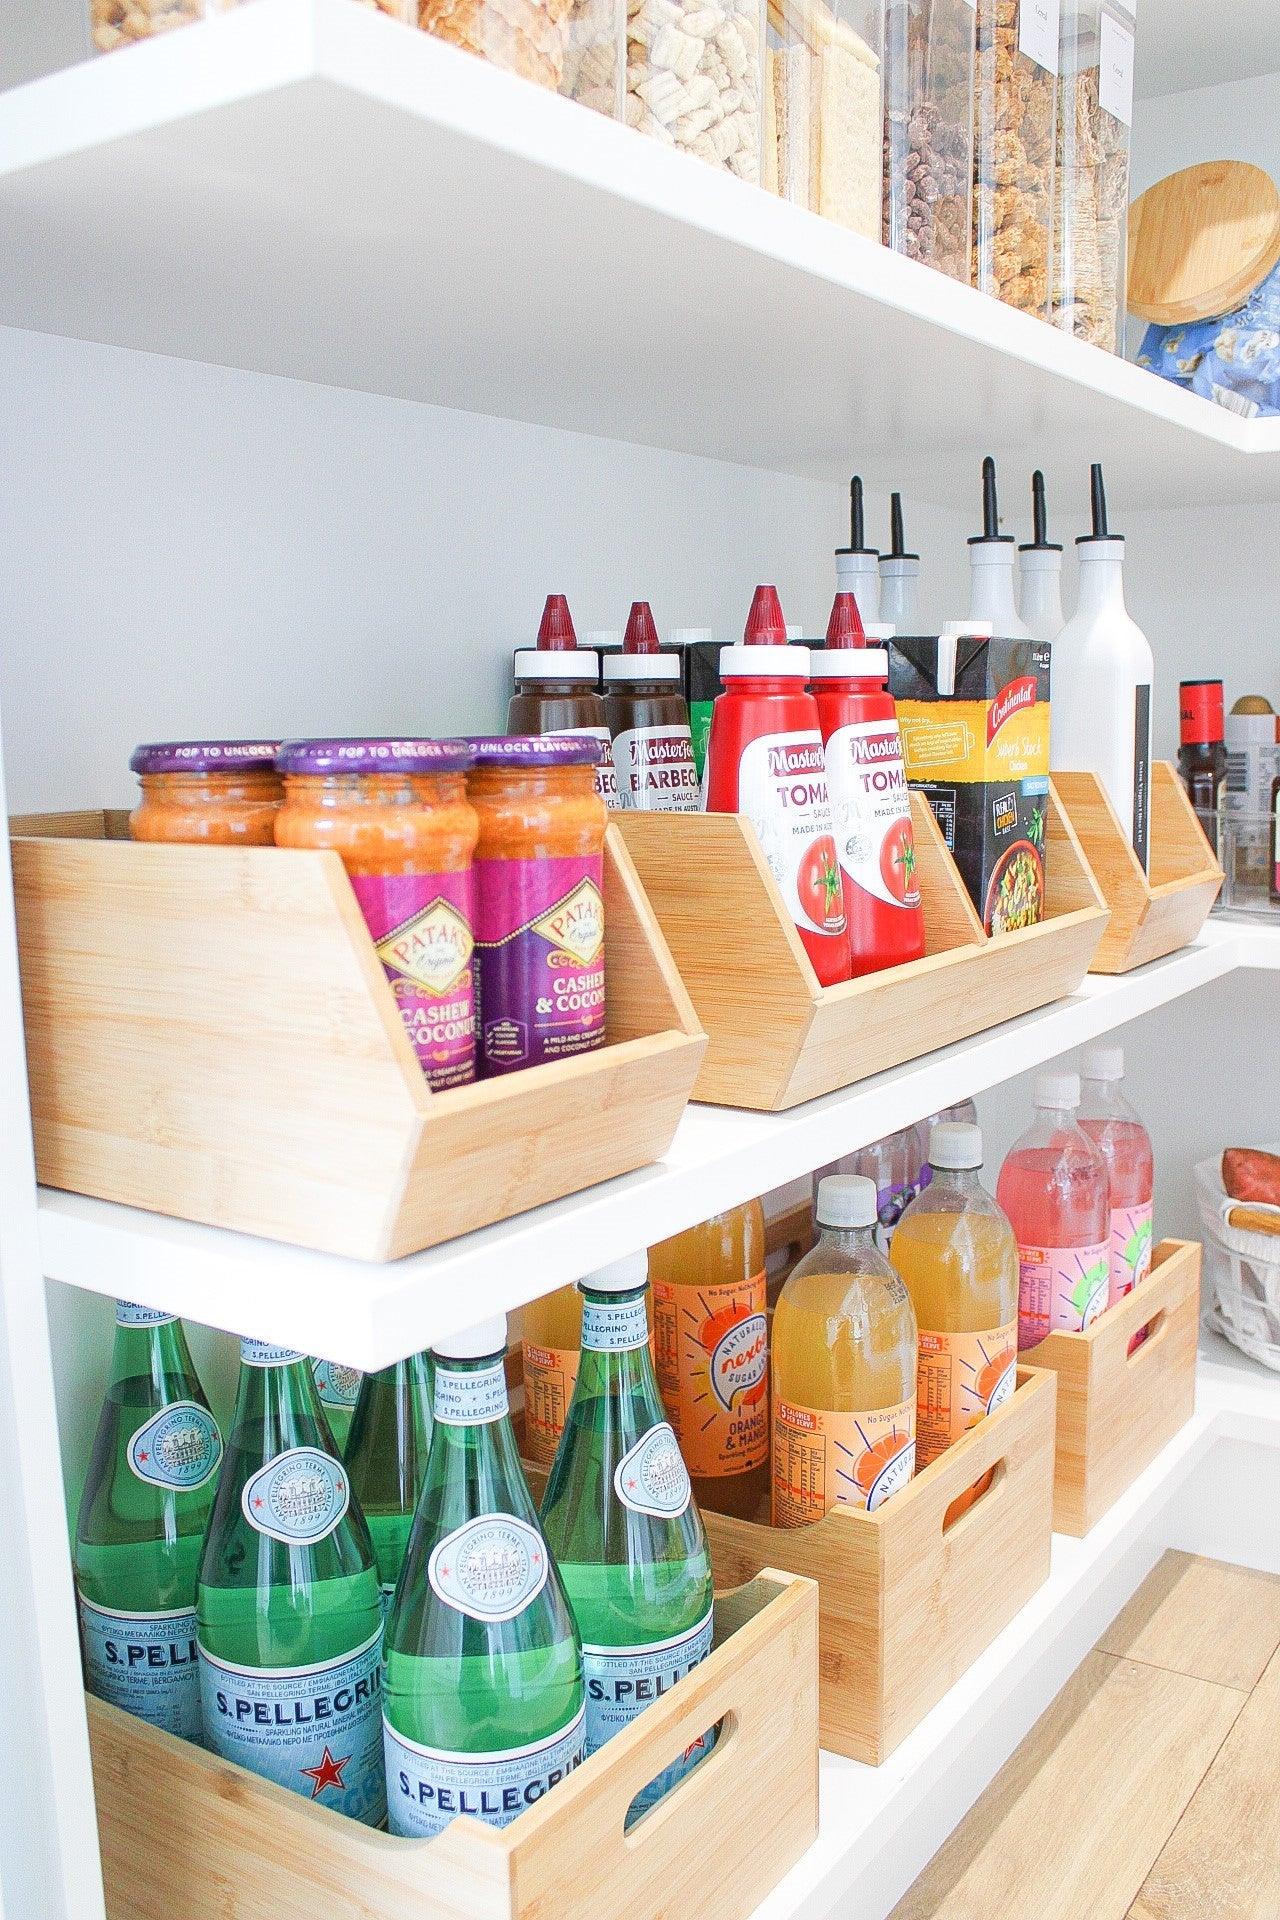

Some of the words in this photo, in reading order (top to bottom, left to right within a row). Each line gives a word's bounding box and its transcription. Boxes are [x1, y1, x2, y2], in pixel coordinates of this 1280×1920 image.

[992, 682, 1034, 729] Continental
[174, 747, 198, 757] POP
[202, 747, 220, 757] TO
[223, 746, 274, 757] UNLOCK
[338, 746, 367, 758] POP
[368, 746, 388, 757] TO
[391, 745, 441, 757] UNLOCK
[480, 743, 530, 753] UNLOCK
[533, 741, 580, 752] FLAVOUR
[672, 793, 693, 801] SAUCE
[875, 808, 893, 817] MADE
[792, 825, 815, 835] MADE
[535, 997, 553, 1013] &
[401, 999, 470, 1025] CASHEW
[550, 1035, 566, 1043] MILD
[544, 1046, 560, 1054] AND
[708, 1289, 717, 1297] No
[442, 1374, 502, 1390] S.PELLEGRINO
[728, 1370, 757, 1383] SUGAR
[444, 1401, 504, 1417] S.PELLEGRINO
[781, 1405, 787, 1418] 5
[786, 1408, 811, 1421] CALORIES
[786, 1415, 795, 1424] PER
[796, 1419, 815, 1428] SERVE
[867, 1416, 876, 1424] No
[156, 1416, 183, 1456] PELLEGRINO
[726, 1435, 736, 1450] &
[305, 1461, 326, 1477] TERME
[271, 1462, 302, 1503] PELLEGRINO
[274, 1505, 288, 1522] SAN
[293, 1513, 321, 1526] 1899
[460, 1532, 495, 1574] PELLEGRINO
[498, 1531, 521, 1548] TERME
[482, 1588, 513, 1600] 1899
[149, 1620, 190, 1631] SPARKLING
[168, 1626, 188, 1636] ΝΕΡΟ
[597, 1660, 628, 1669] BOTTLED
[655, 1651, 680, 1663] SOURCE
[644, 1658, 683, 1673] PELLEGRINO
[273, 1682, 301, 1690] SOURCE
[262, 1689, 307, 1698] PELLEGRINO
[265, 1727, 302, 1737] SPARKLING
[303, 1720, 332, 1734] NATURAL
[333, 1710, 355, 1726] MINERAL
[601, 1714, 625, 1723] ΦΥΣΙΚΟ
[282, 1737, 301, 1746] ΝΕΡΟ
[302, 1735, 313, 1743] ΜΕ
[457, 1769, 490, 1777] SOURCE
[445, 1776, 494, 1784] PELLEGRINO
